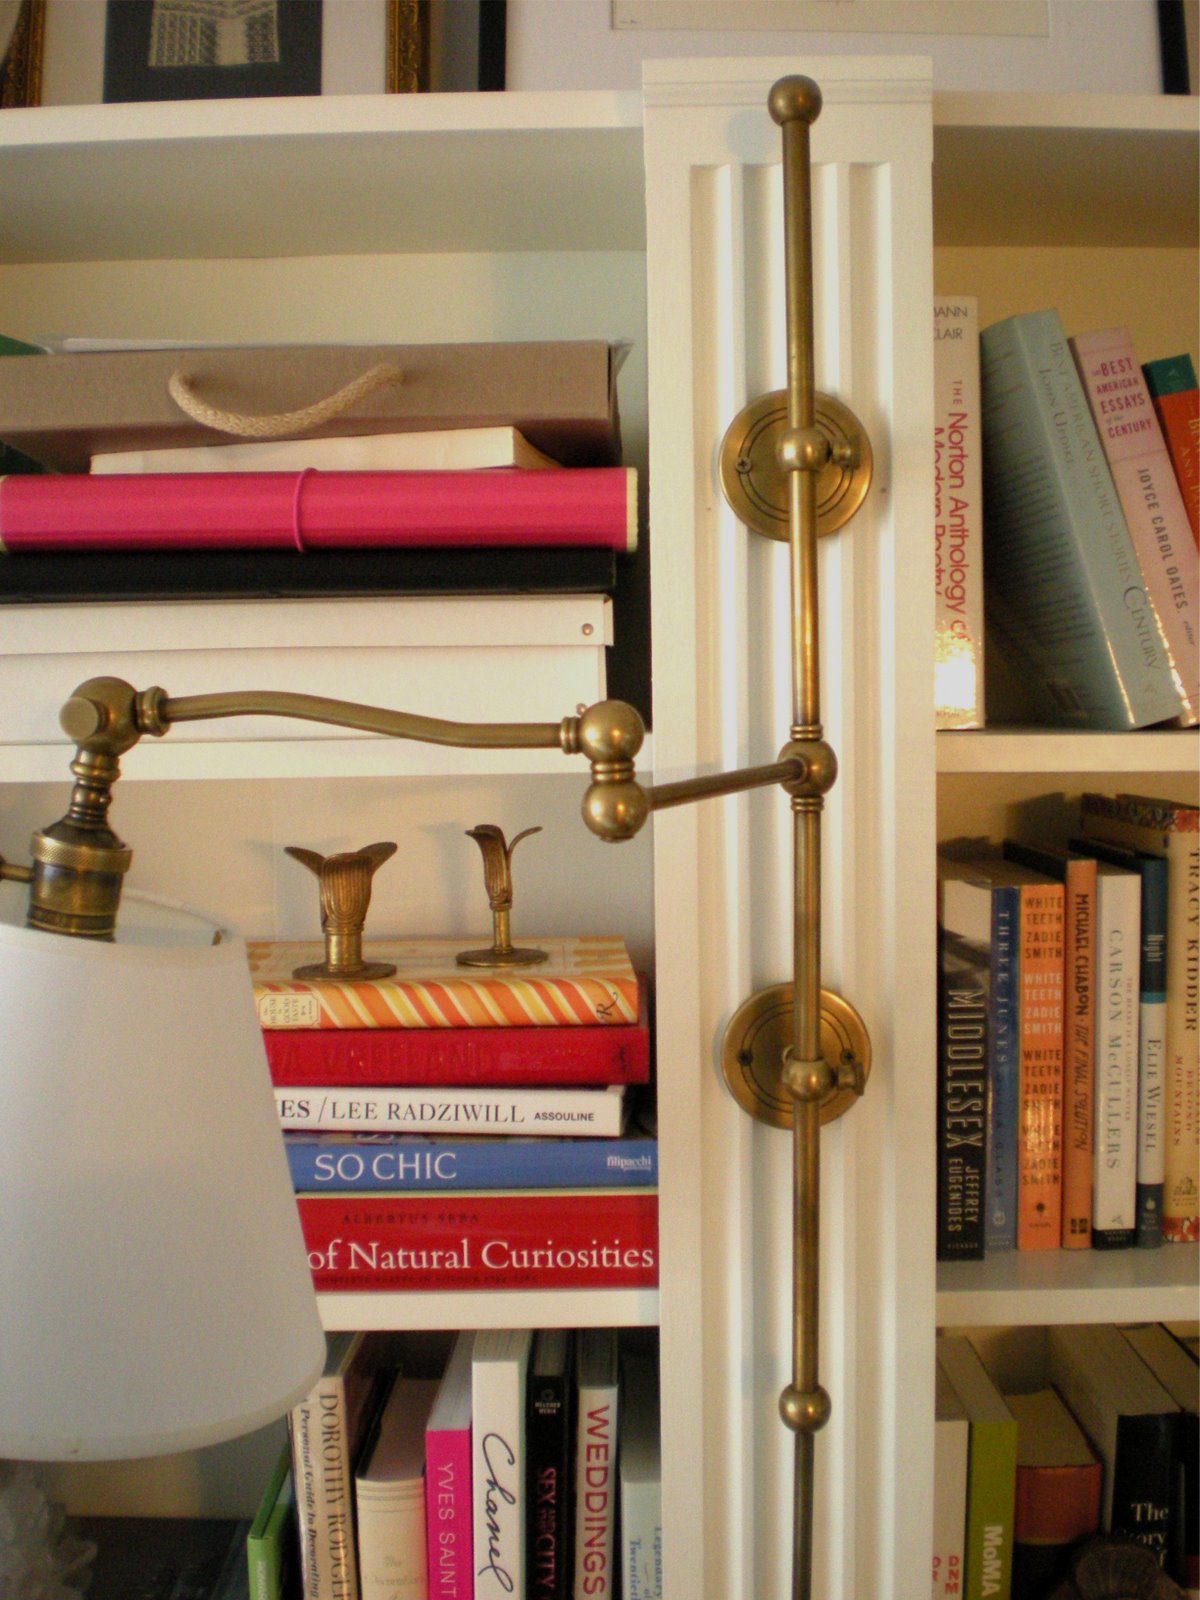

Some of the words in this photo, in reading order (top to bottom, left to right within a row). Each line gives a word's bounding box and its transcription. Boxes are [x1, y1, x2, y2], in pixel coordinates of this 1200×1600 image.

[1096, 376, 1139, 394] AMERICAN
[1100, 357, 1134, 377] BEST
[952, 380, 963, 405] THE
[1100, 392, 1145, 415] ESSAYS
[1107, 418, 1152, 439] CENTURY
[948, 412, 969, 489] Norton
[1137, 467, 1161, 511] JOYCE
[1151, 515, 1175, 561] CAROL
[945, 496, 970, 615] Anthology
[1025, 897, 1063, 909] WHITE
[1187, 847, 1199, 927] TRACY
[1026, 913, 1063, 925] TEETH
[1026, 931, 1062, 943] ZADIE
[1075, 893, 1090, 953] MICHAEL
[997, 910, 1010, 983] THREE
[1025, 948, 1063, 959] SMITH
[1023, 973, 1062, 985] WHITE
[1024, 989, 1062, 1001] TEETH
[1075, 954, 1090, 1016] CHABON
[1108, 929, 1124, 1022] CARSON
[1185, 938, 1199, 1032] KIDDER
[996, 997, 1009, 1063] JUNES
[1023, 1022, 1062, 1035] SMITH
[1025, 1006, 1061, 1019] ZADIE
[1075, 1023, 1090, 1046] THE
[946, 988, 985, 1149] MIDDLESEX
[1023, 1050, 1062, 1061] WHITE
[1024, 1066, 1061, 1077] TEETH
[1075, 1048, 1089, 1085] FINAL
[1147, 1039, 1161, 1080] ELIE
[1024, 1083, 1060, 1095] ZADIE
[1106, 1034, 1123, 1169] McCULLERS
[1172, 1054, 1184, 1147] MOUNTAINS
[1185, 1069, 1195, 1133] BEYOND
[331, 1100, 379, 1120] LEE
[387, 1101, 526, 1124] RADZIWILL
[534, 1111, 595, 1123] ASSOULINE
[1145, 1085, 1161, 1150] WIESEL
[314, 1153, 365, 1182] SO
[372, 1151, 458, 1181] CHIC
[1023, 1159, 1060, 1170] ZADIE
[947, 1157, 963, 1233] EUGENIDES
[964, 1164, 980, 1224] JEFFREY
[307, 1239, 342, 1271] of
[348, 1239, 471, 1271] Natural
[480, 1238, 654, 1271] Curiosities
[300, 1408, 313, 1468] Personal
[319, 1393, 344, 1504] DOROTHY
[304, 1470, 317, 1508] Guide
[437, 1462, 456, 1521] YVES
[536, 1466, 558, 1506] SEX
[582, 1404, 610, 1596] WEDDINGS
[307, 1511, 317, 1525] to
[477, 1432, 516, 1595] Chanel
[1130, 1503, 1169, 1522] The
[307, 1527, 321, 1598] Decorating
[438, 1533, 457, 1599] SAINT
[535, 1533, 557, 1588] CITY
[629, 1538, 643, 1600] Twentiet
[981, 1525, 1004, 1597] MoMA
